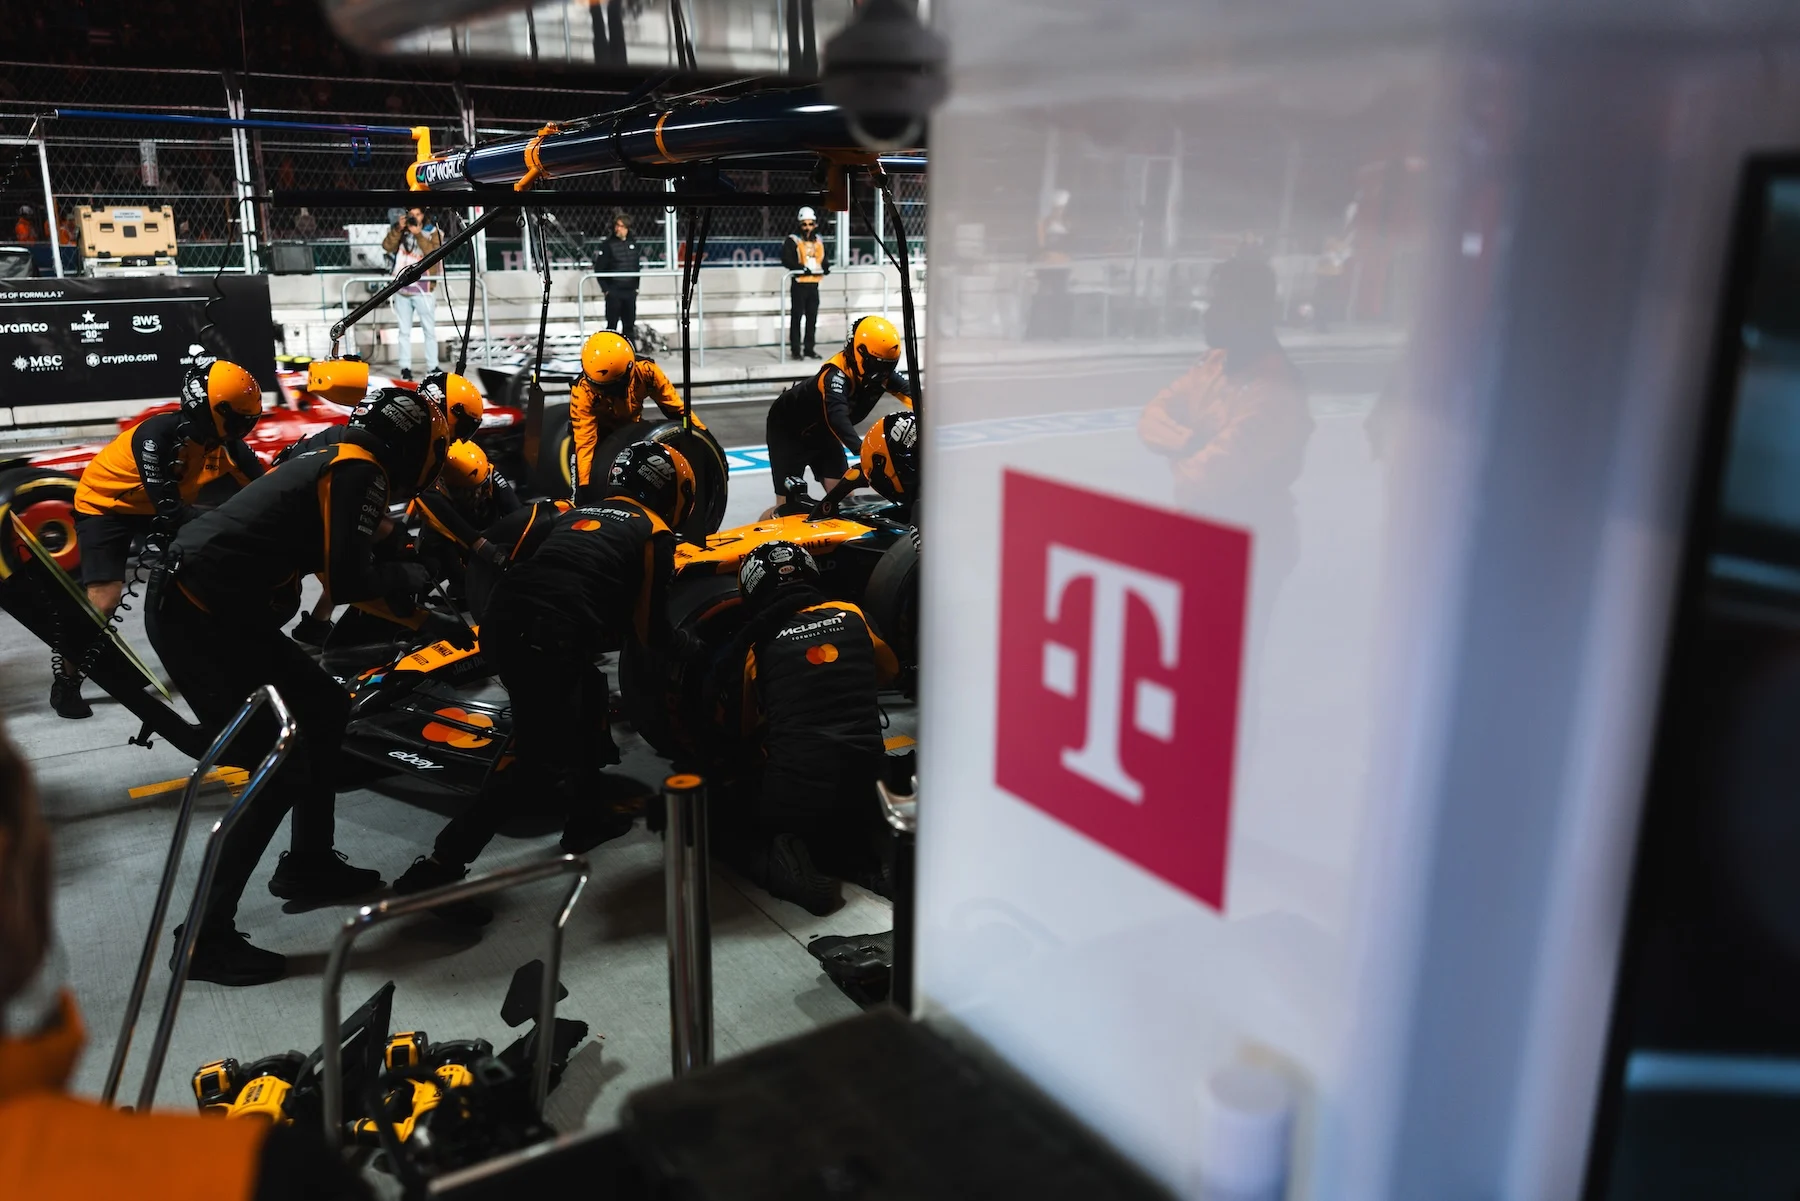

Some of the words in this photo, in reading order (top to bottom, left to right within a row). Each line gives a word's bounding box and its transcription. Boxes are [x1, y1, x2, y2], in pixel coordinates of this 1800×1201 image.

[19, 290, 56, 298] FORMULA
[71, 321, 109, 331] Heineken
[132, 313, 160, 326] aws
[30, 355, 63, 367] MSC
[102, 353, 157, 366] crypto.com
[576, 506, 631, 519] McLaren
[776, 617, 842, 639] McLaren
[1043, 544, 1181, 805] T
[387, 750, 445, 770] ebay
